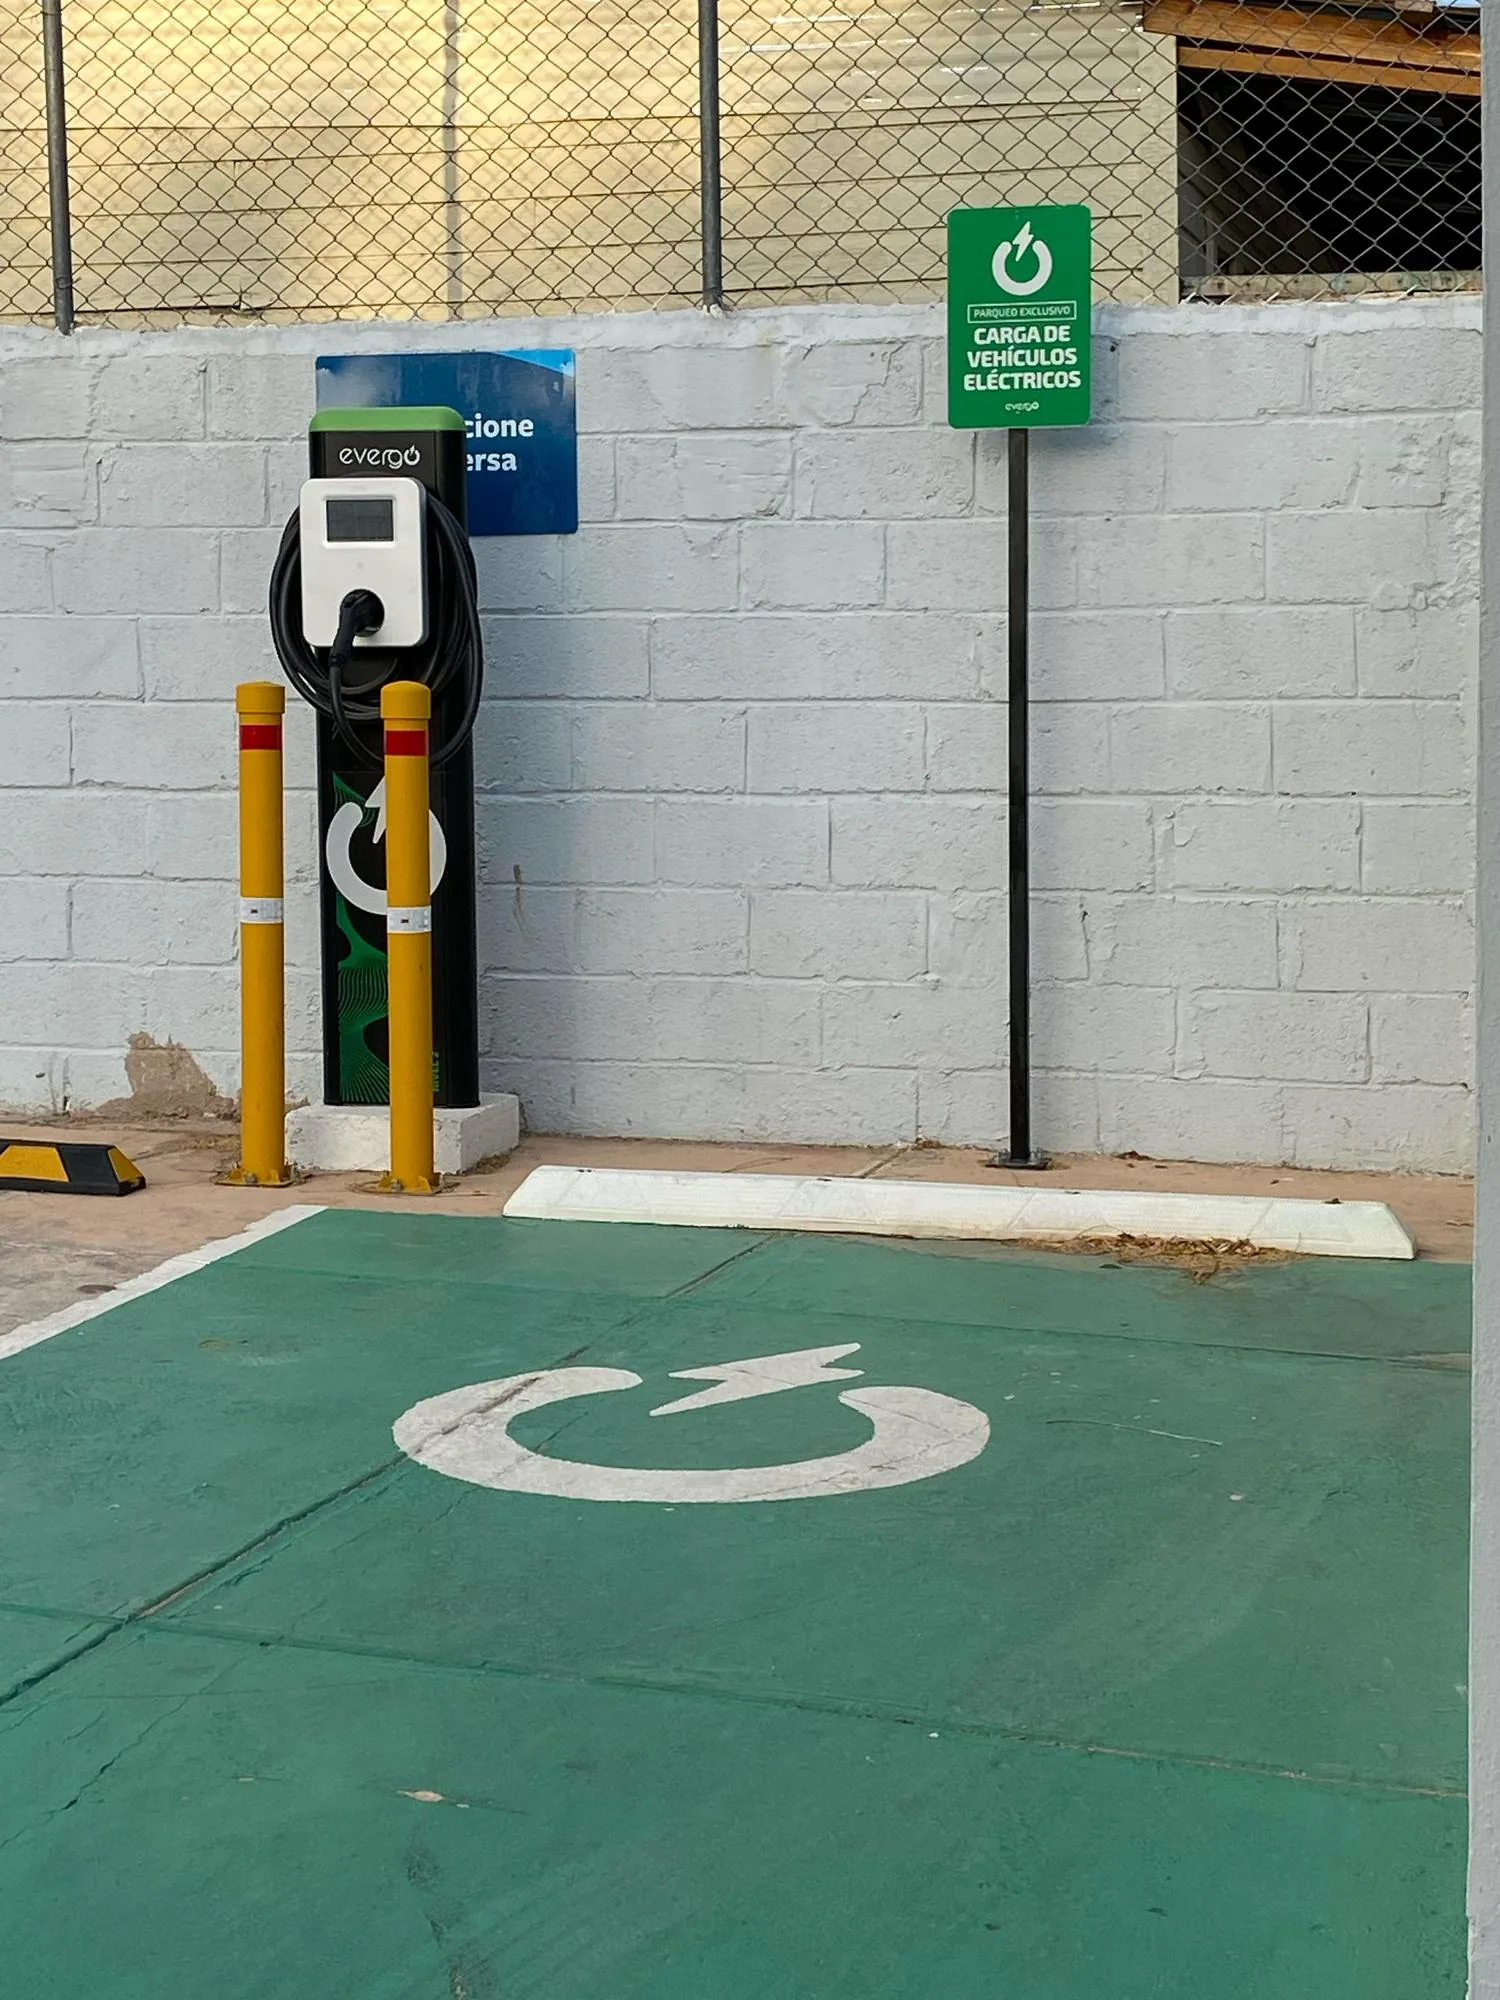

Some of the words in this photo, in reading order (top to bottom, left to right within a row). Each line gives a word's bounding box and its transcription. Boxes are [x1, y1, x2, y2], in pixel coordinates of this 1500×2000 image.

[973, 307, 1018, 318] PARQUEO
[1019, 305, 1071, 316] EXCLUSIVO
[974, 326, 1041, 345] CARGA
[1043, 325, 1072, 343] DE
[966, 345, 1078, 368] VEHÍCULOS
[963, 368, 1082, 391] ELÉCTRICOS
[339, 445, 421, 469] evergo
